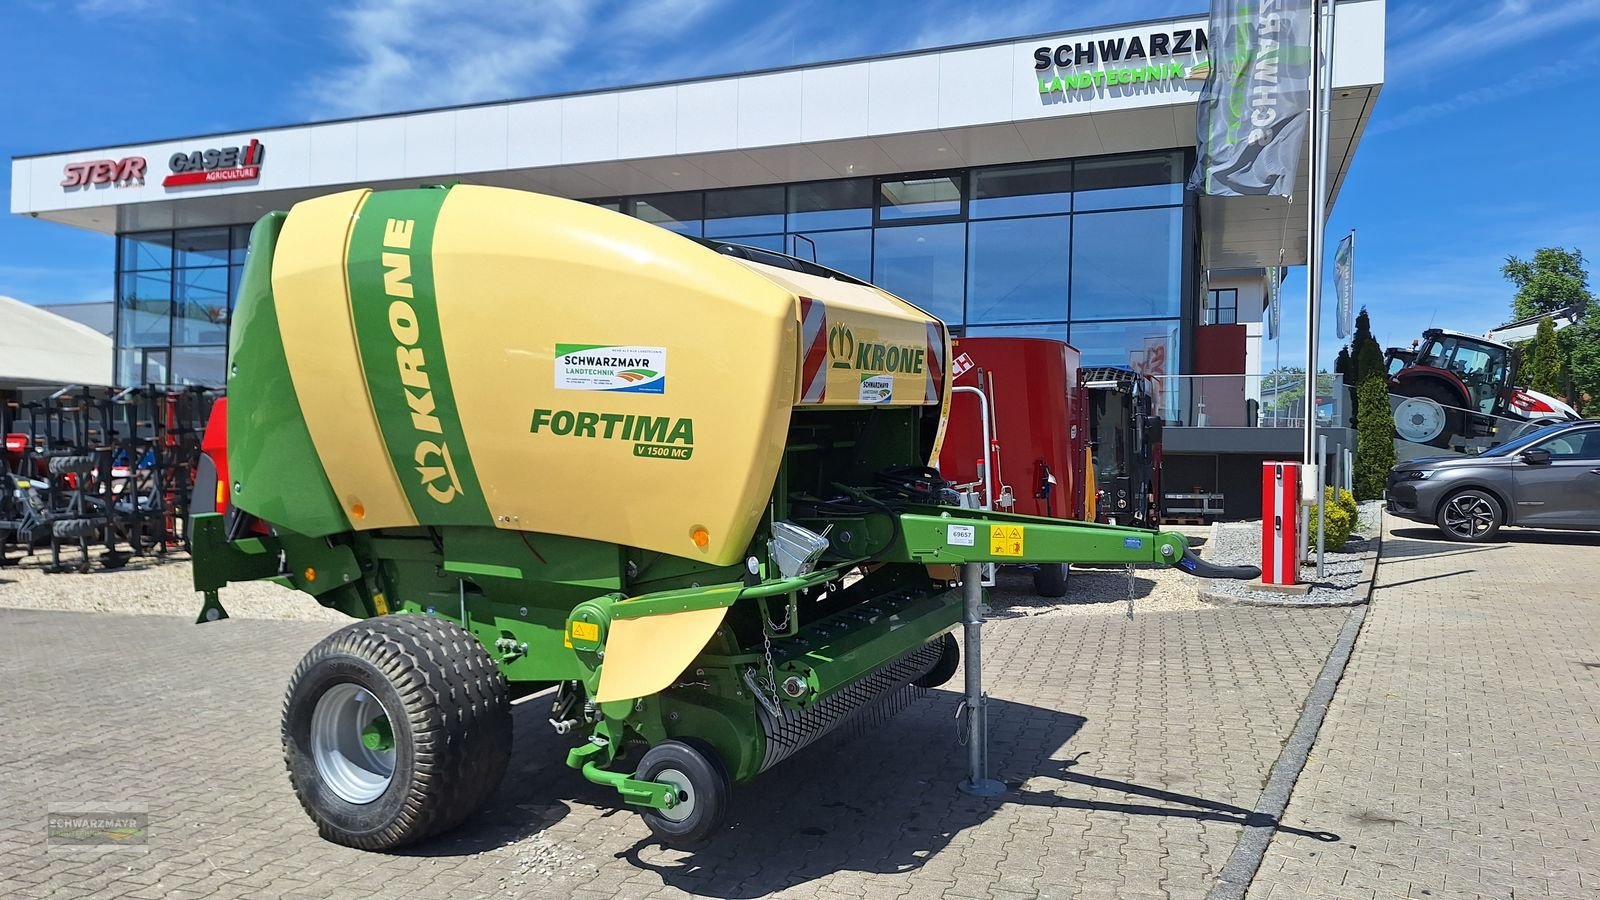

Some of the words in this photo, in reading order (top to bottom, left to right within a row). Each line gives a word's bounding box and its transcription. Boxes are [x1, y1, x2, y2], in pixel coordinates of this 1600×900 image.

[1039, 62, 1184, 93] LANDTECHNIK
[61, 157, 147, 187] STEYR
[169, 147, 239, 172] CASE
[206, 167, 254, 181] AGRICULTURE
[382, 217, 443, 434] KRONE
[564, 355, 650, 368] SCHWARZMAYR
[855, 342, 924, 374] KRONE
[565, 368, 615, 376] LANDTECHNIK
[530, 409, 694, 445] FORTIMA
[637, 446, 645, 455] V
[647, 447, 669, 456] 1500
[671, 448, 688, 458] MC
